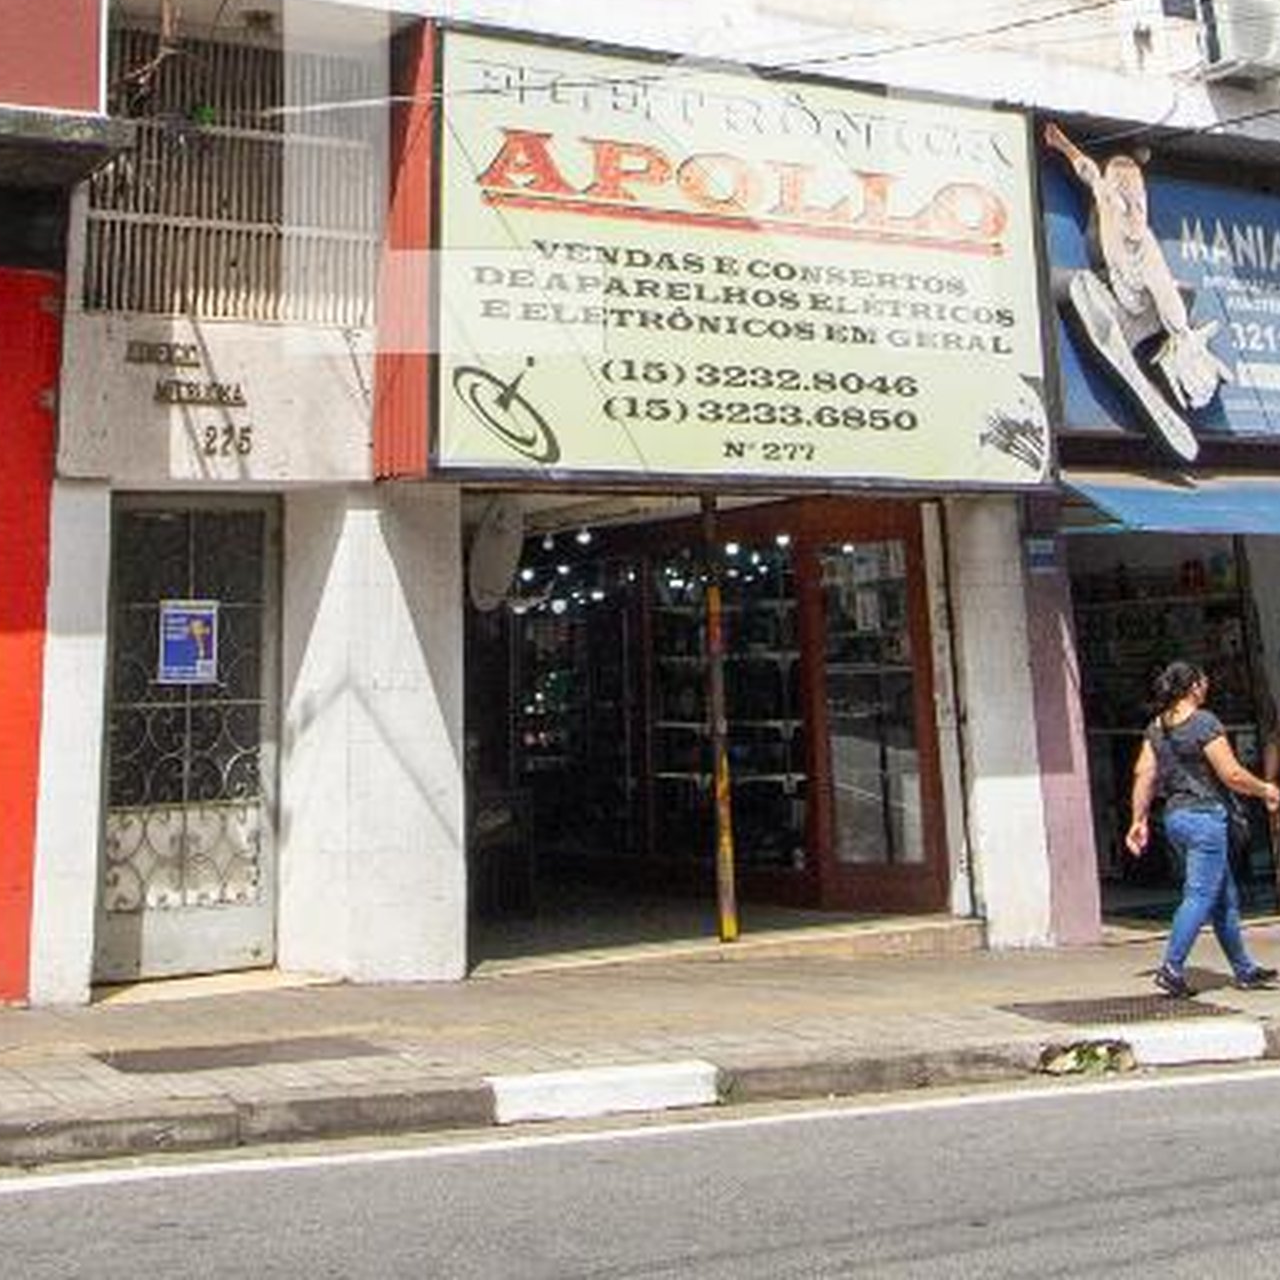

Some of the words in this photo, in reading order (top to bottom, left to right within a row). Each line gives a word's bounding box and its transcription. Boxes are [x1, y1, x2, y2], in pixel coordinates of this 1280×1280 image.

[477, 127, 1009, 239] APOLLO
[473, 265, 535, 288] DE
[543, 272, 801, 311] APARELHOS
[532, 239, 705, 274] VENDAS
[713, 256, 739, 276] E
[747, 259, 968, 298] CONSERTOS
[479, 299, 511, 320] E
[519, 302, 815, 342] ELETRÔNICOS
[825, 323, 877, 345] EM
[886, 329, 1013, 355] GERAL
[601, 359, 687, 385] (15)
[694, 363, 919, 398] 3232.8046
[602, 396, 689, 425] (15)
[696, 399, 919, 432] 3233.6850
[762, 442, 816, 461] 277
